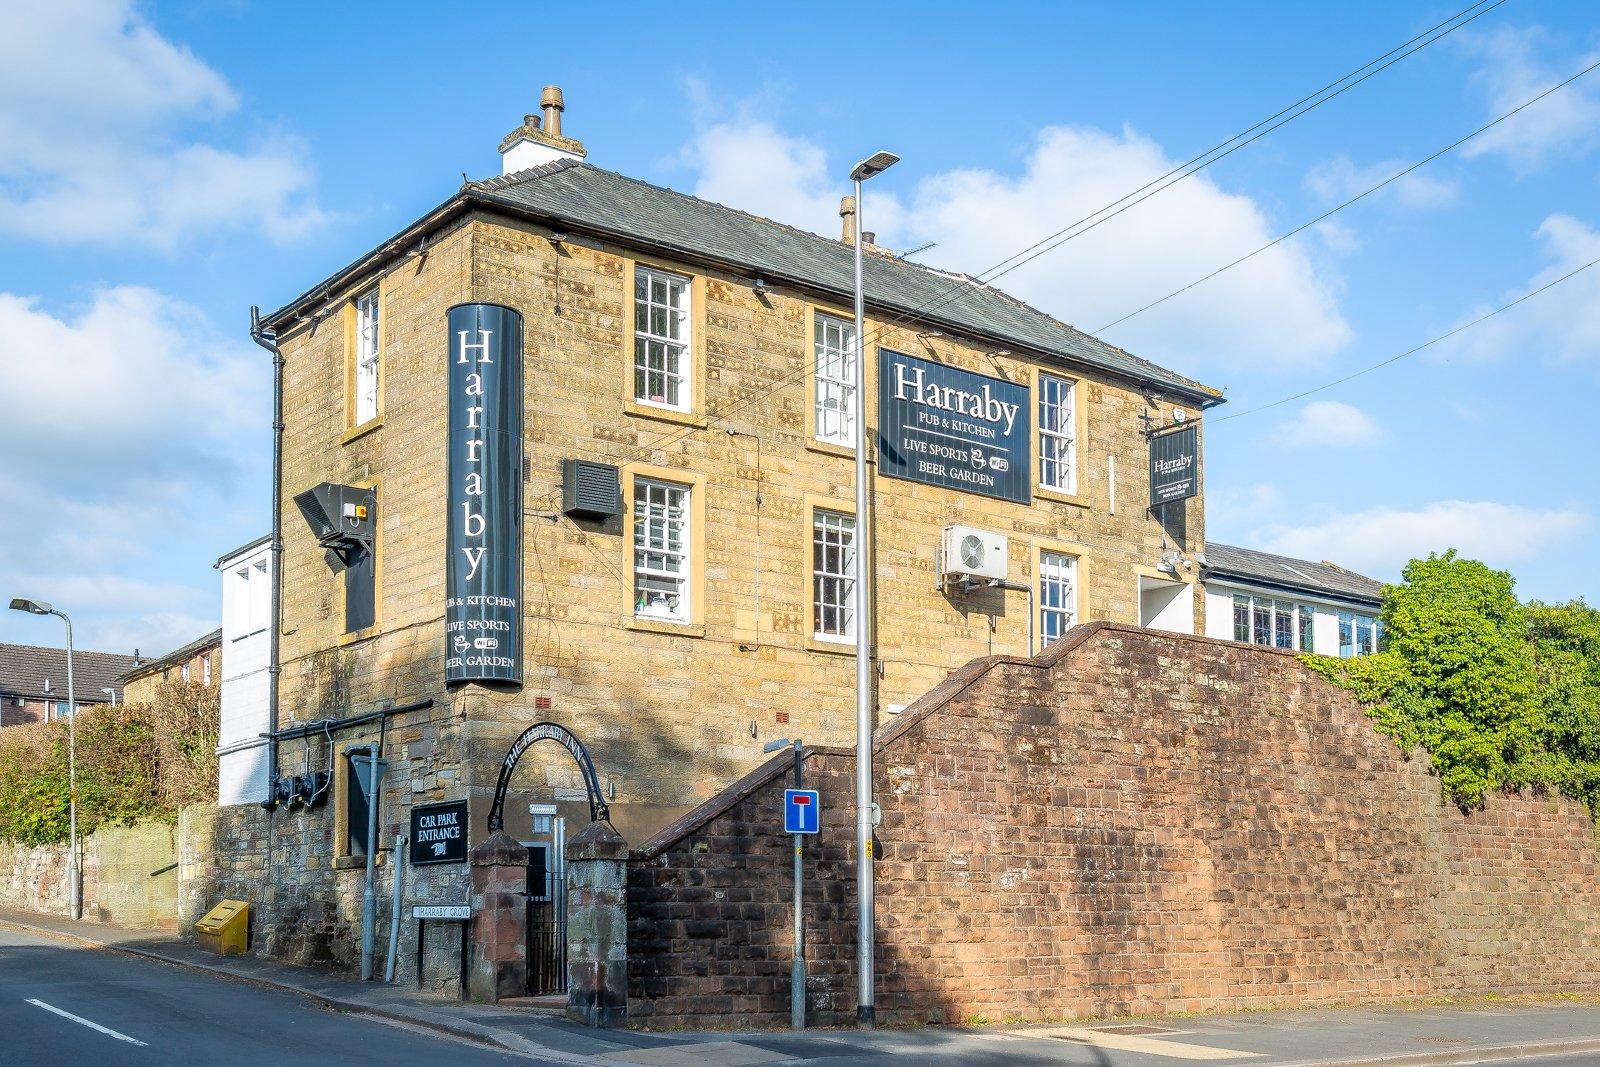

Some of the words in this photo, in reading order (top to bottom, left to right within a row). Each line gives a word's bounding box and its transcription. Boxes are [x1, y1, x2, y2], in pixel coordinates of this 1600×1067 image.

[893, 362, 1019, 437] Harraby
[919, 412, 940, 426] PUB
[942, 418, 950, 428] &
[951, 419, 996, 440] KITCHEN
[457, 330, 493, 581] Harraby
[903, 438, 927, 452] LIVE
[929, 444, 968, 462] SPORTS
[1154, 454, 1192, 472] Harraby
[918, 460, 947, 477] BEER
[949, 468, 995, 487] GARDEN
[456, 598, 464, 606] &
[466, 596, 516, 608] KITCHEN
[447, 620, 465, 632] LIVE
[467, 620, 510, 631] SPORTS
[466, 656, 514, 668] GARDEN
[420, 815, 436, 828] CAR
[437, 812, 458, 826] PARK
[418, 826, 460, 842] ENTRANCE
[420, 907, 448, 917] HARRABY
[450, 907, 469, 917] GROVE
